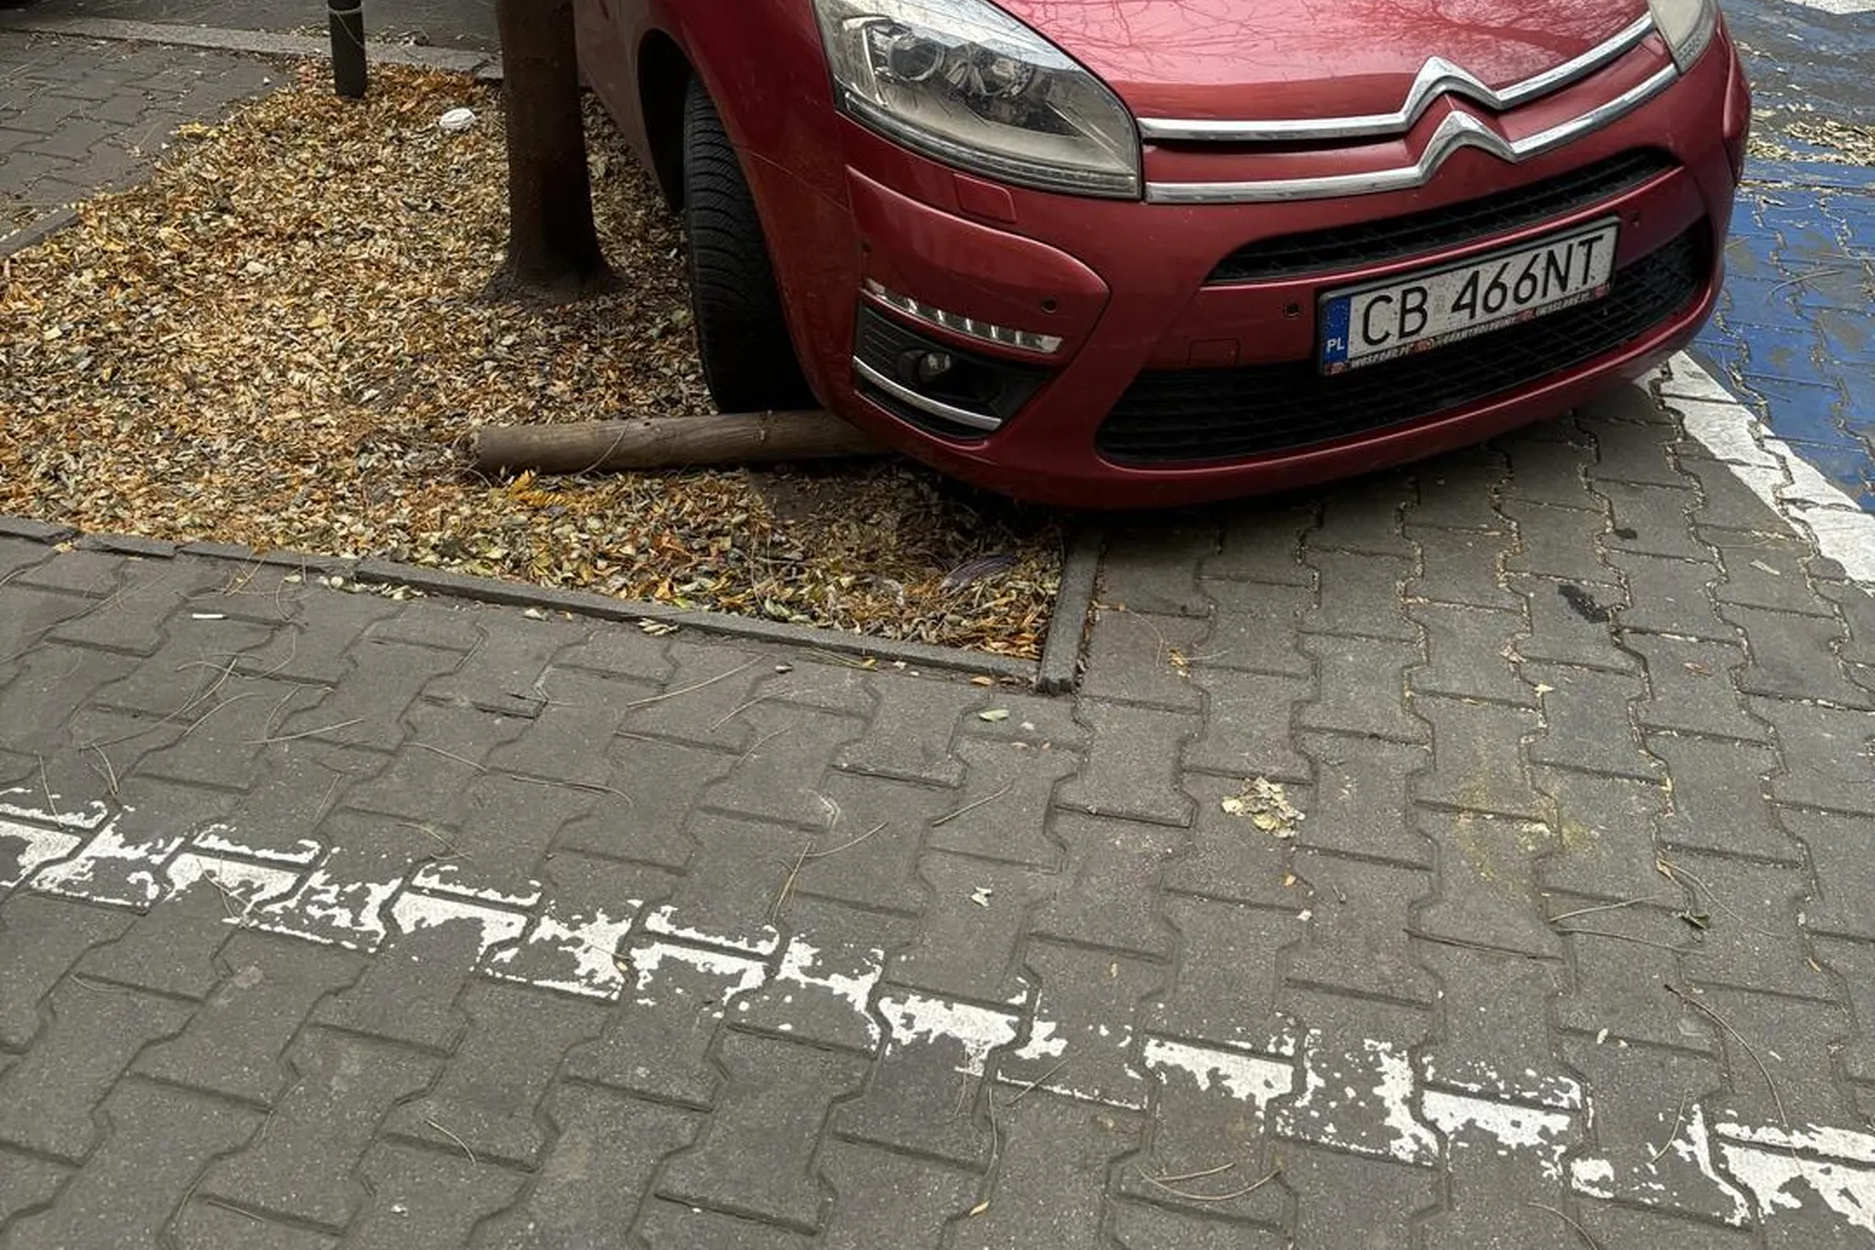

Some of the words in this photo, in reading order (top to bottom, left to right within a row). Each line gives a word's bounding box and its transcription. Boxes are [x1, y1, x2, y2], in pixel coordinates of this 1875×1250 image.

[1362, 286, 1429, 346] CB
[1451, 235, 1604, 321] 466NT
[1326, 337, 1345, 353] PL
